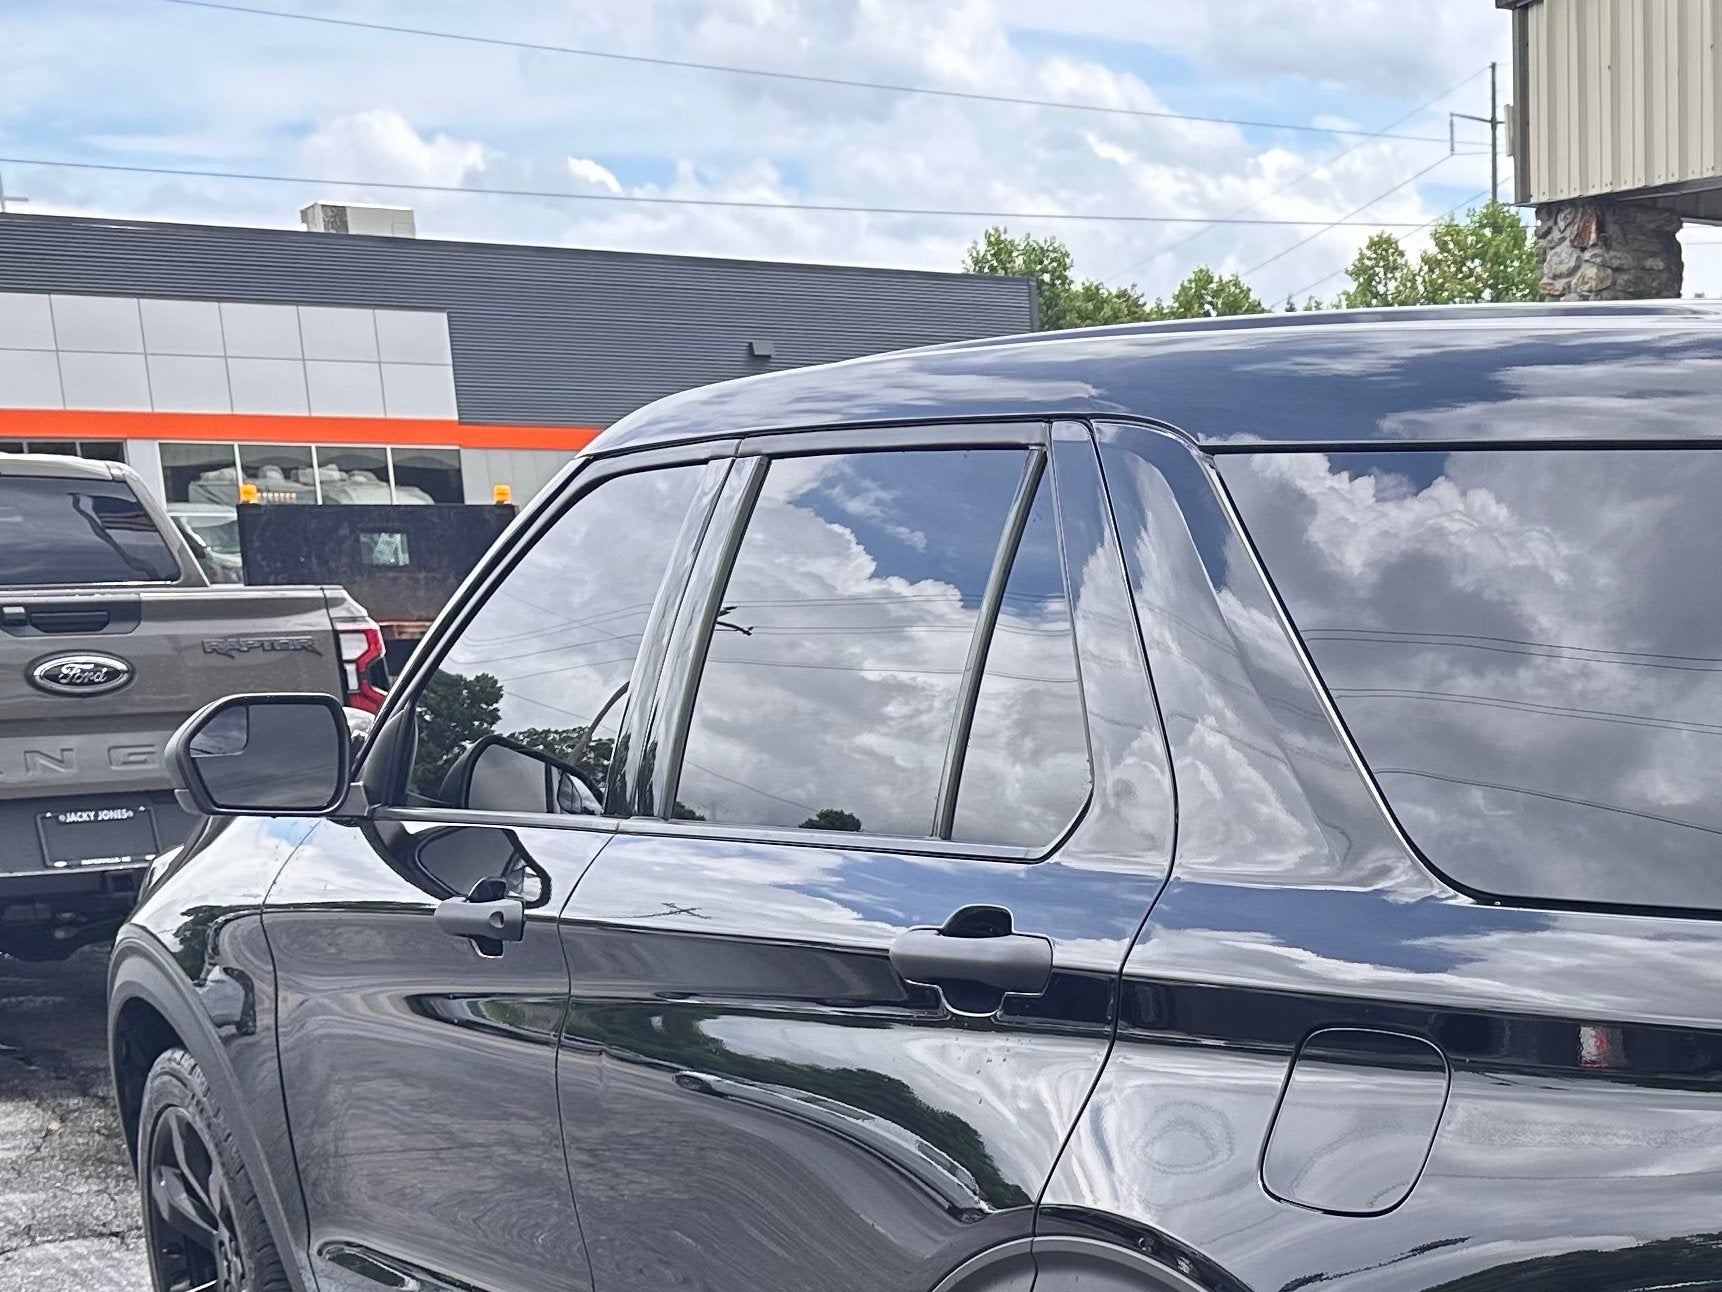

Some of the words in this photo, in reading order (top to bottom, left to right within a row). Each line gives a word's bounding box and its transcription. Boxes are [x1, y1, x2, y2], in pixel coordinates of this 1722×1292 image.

[202, 636, 323, 660] RAPTOR
[58, 663, 108, 684] Ford
[0, 743, 161, 777] NG
[66, 811, 95, 823] JACKY
[98, 809, 128, 821] JONES
